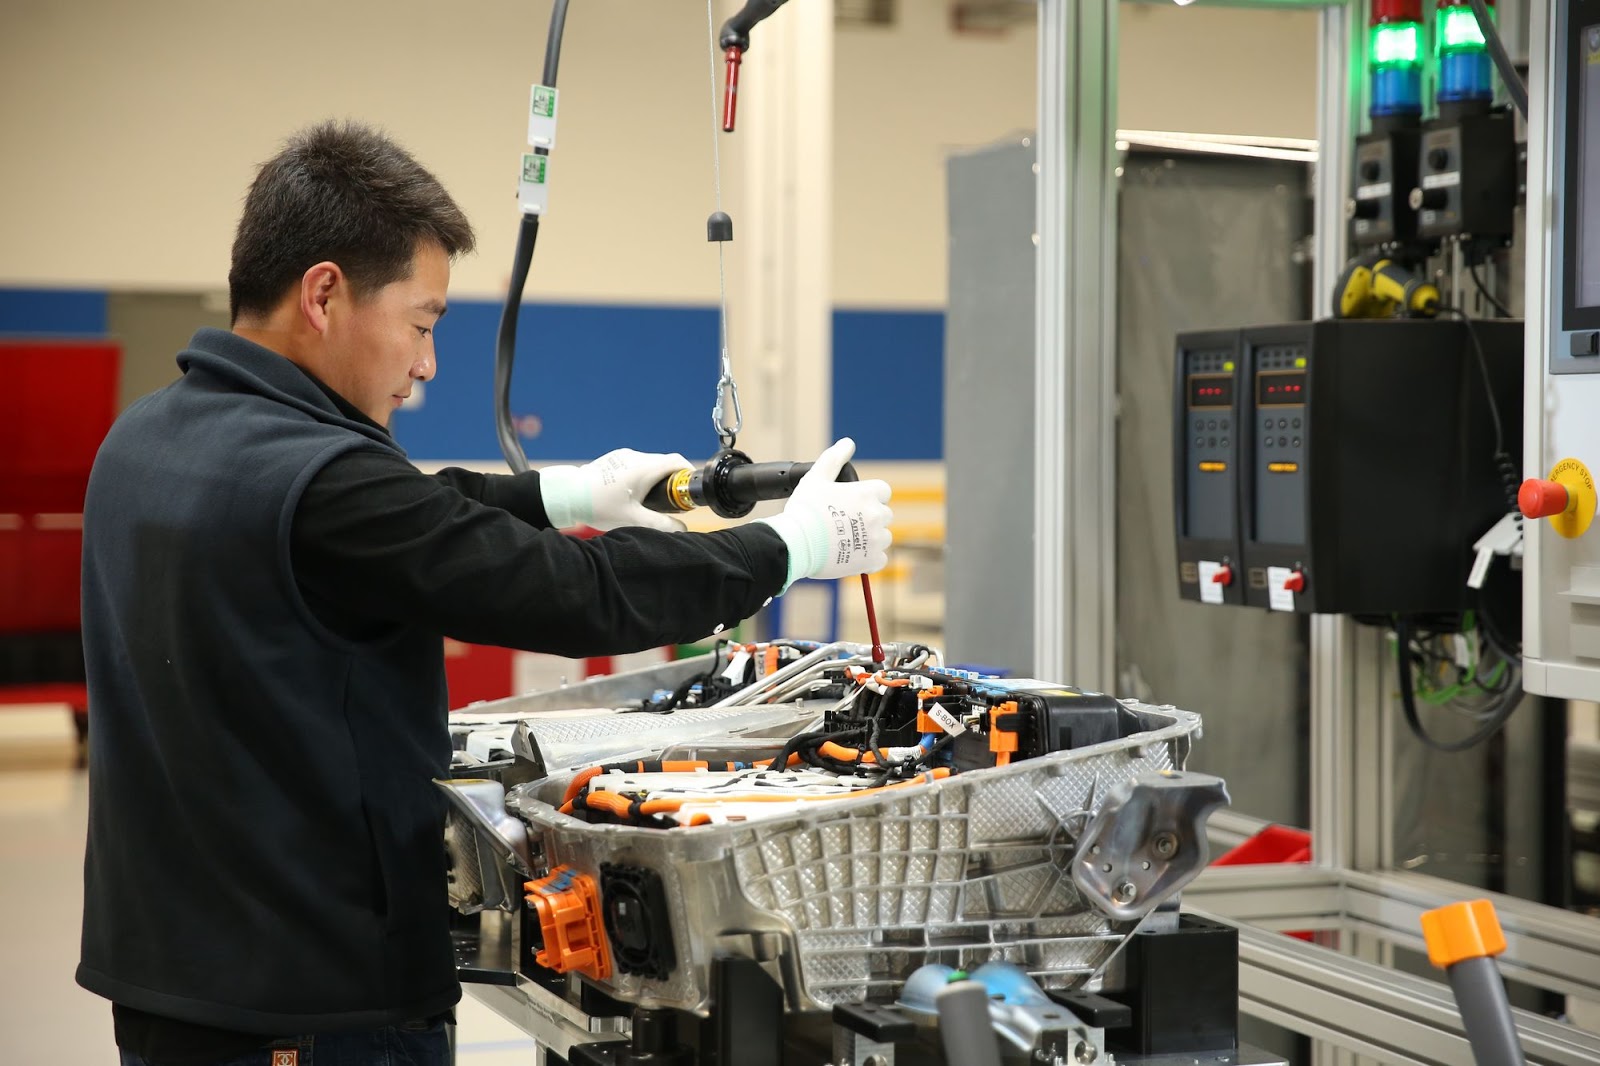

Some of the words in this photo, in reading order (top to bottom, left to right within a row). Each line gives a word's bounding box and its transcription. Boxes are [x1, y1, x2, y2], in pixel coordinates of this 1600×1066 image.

[1580, 468, 1592, 490] STOP
[851, 518, 862, 551] Ansell
[935, 709, 956, 730] S-BOX
